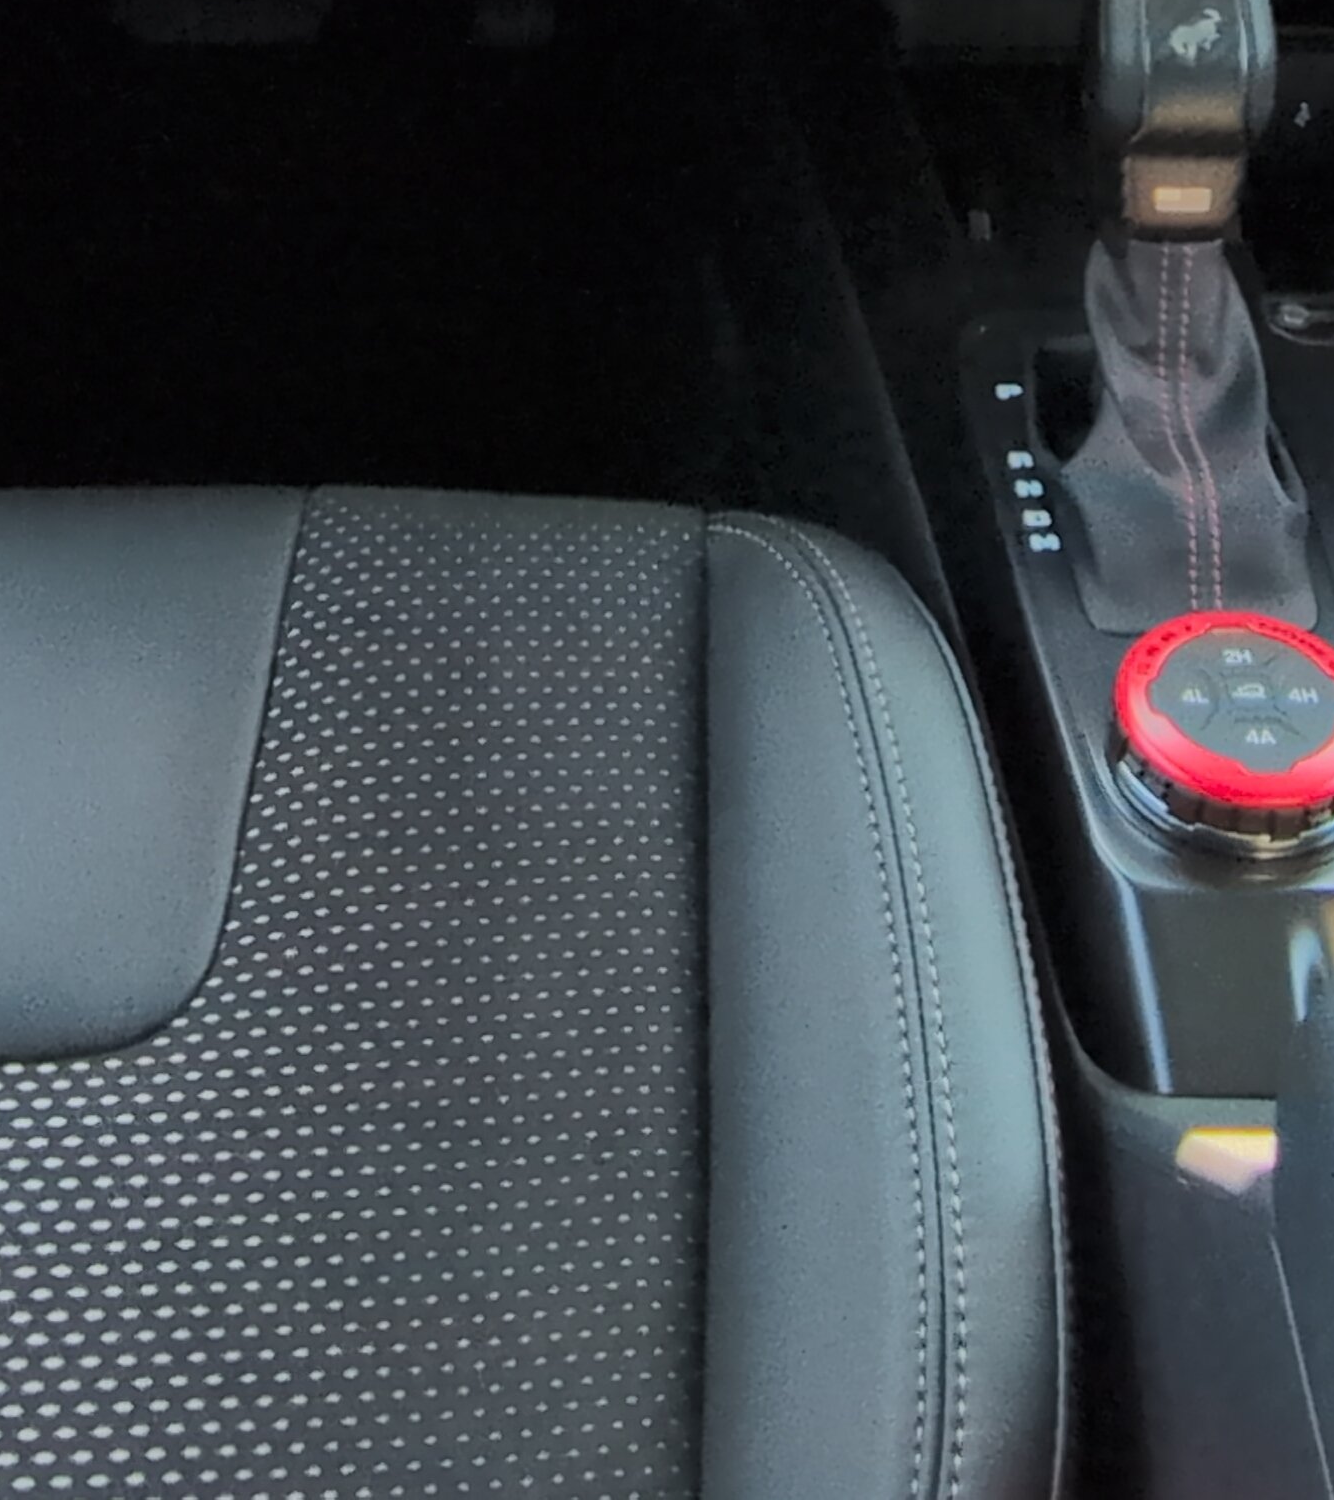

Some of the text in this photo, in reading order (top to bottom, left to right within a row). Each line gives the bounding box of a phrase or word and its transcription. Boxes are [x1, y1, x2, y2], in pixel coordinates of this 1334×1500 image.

[1223, 648, 1252, 665] 2H
[1181, 688, 1209, 705] 4L
[1287, 687, 1318, 704] 4H
[1245, 729, 1277, 745] 4A
